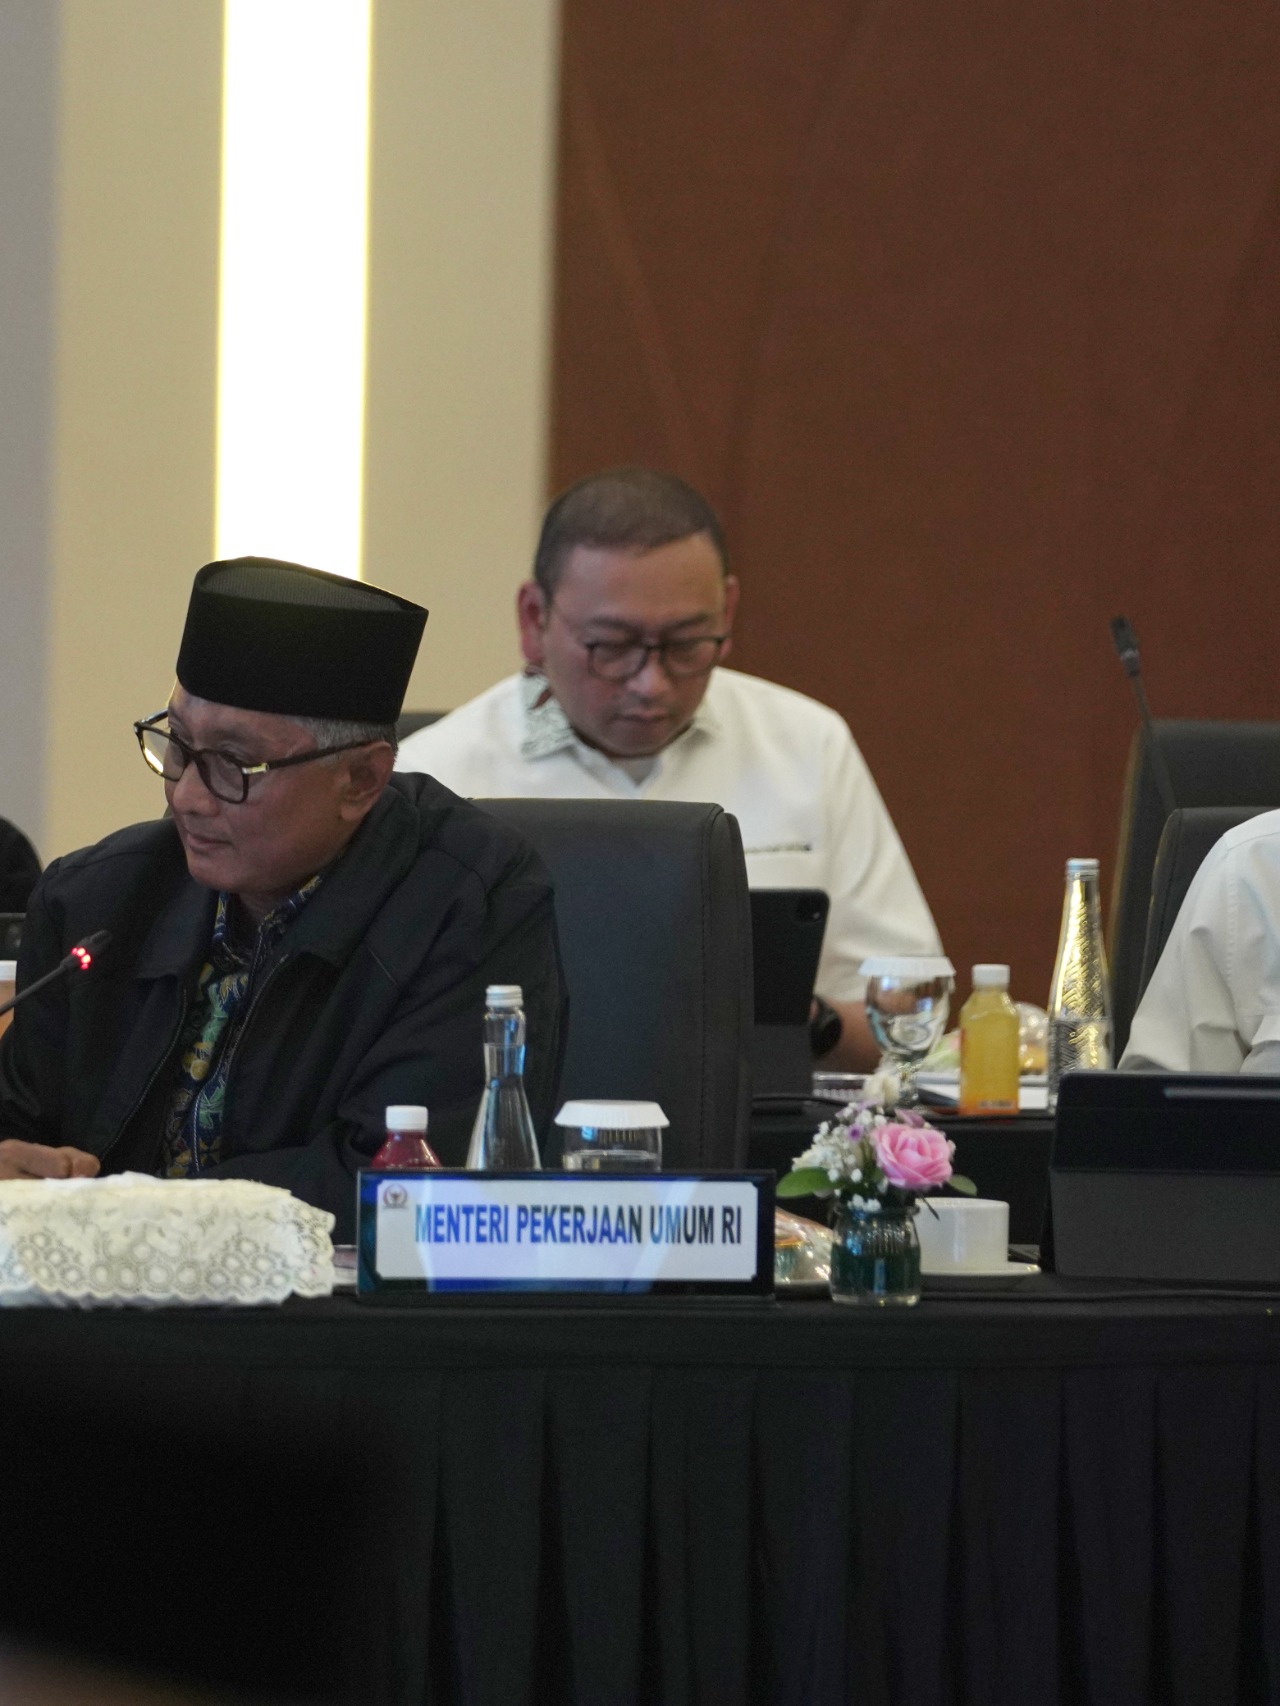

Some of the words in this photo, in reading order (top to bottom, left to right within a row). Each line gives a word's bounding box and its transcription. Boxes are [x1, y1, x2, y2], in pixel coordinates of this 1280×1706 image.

[415, 1204, 509, 1243] MENTERI
[516, 1204, 643, 1244] PEKERJAAN
[649, 1205, 715, 1244] UMUM
[721, 1205, 742, 1244] RI
